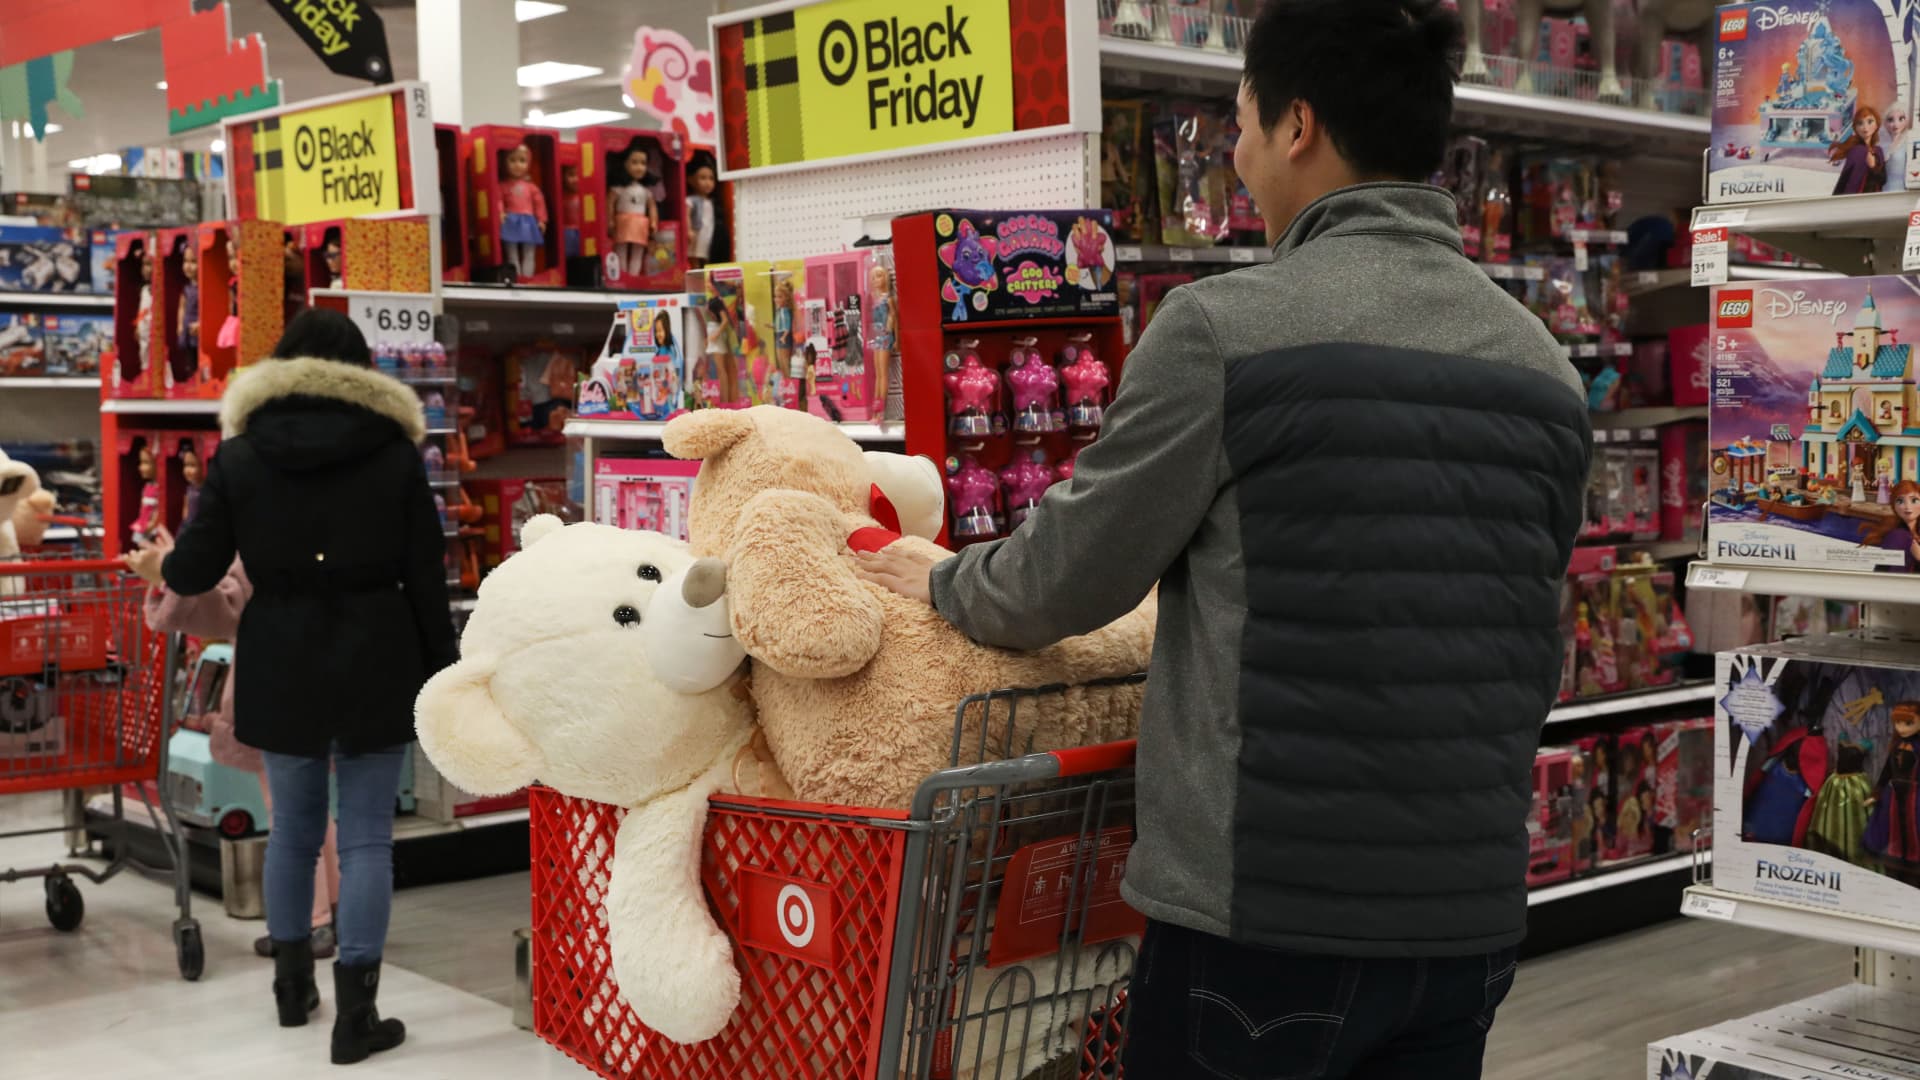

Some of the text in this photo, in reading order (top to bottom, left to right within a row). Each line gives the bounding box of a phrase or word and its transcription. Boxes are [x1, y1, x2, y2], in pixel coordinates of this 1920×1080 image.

[283, 0, 350, 55] iday
[1721, 19, 1746, 33] LEGO
[864, 5, 972, 73] Black
[1718, 48, 1735, 60] 6+
[1717, 80, 1735, 89] 300
[868, 69, 984, 130] Friday
[318, 120, 376, 163] Black
[321, 165, 383, 206] Friday
[1720, 178, 1785, 197] FROZEN II
[1694, 230, 1723, 244] Sale!
[1021, 267, 1043, 279] GOO
[1007, 279, 1058, 293] CRITTERS
[1719, 301, 1751, 317] LEGO
[1716, 336, 1738, 350] 5+
[1716, 378, 1731, 387] 521
[1717, 541, 1796, 561] FROZEN II
[1755, 860, 1825, 887] FROZEN
[1829, 871, 1841, 892] II
